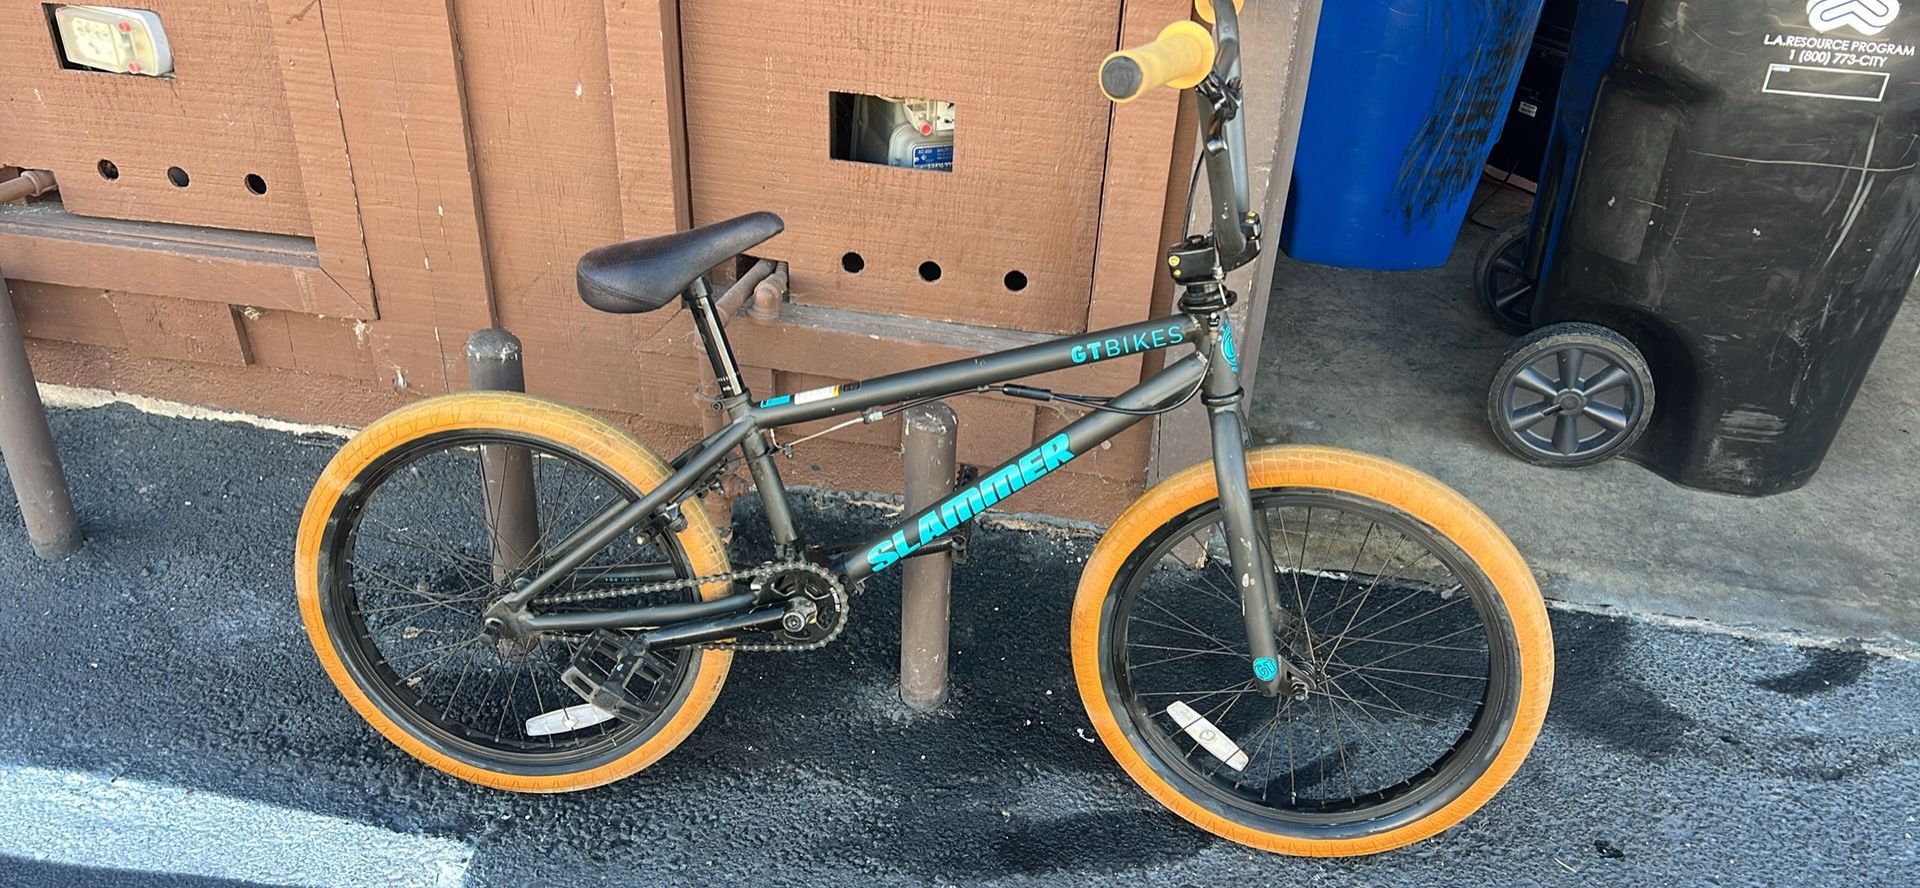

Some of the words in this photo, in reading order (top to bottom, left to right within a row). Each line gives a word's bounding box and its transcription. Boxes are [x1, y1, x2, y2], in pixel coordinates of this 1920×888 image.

[1789, 49, 1797, 61] 1
[1798, 50, 1831, 65] (800)
[1832, 53, 1888, 68] 773-CITY
[1851, 41, 1915, 57] PROGRAM
[866, 432, 1075, 573] SLAMMER
[1254, 659, 1277, 678] GT
